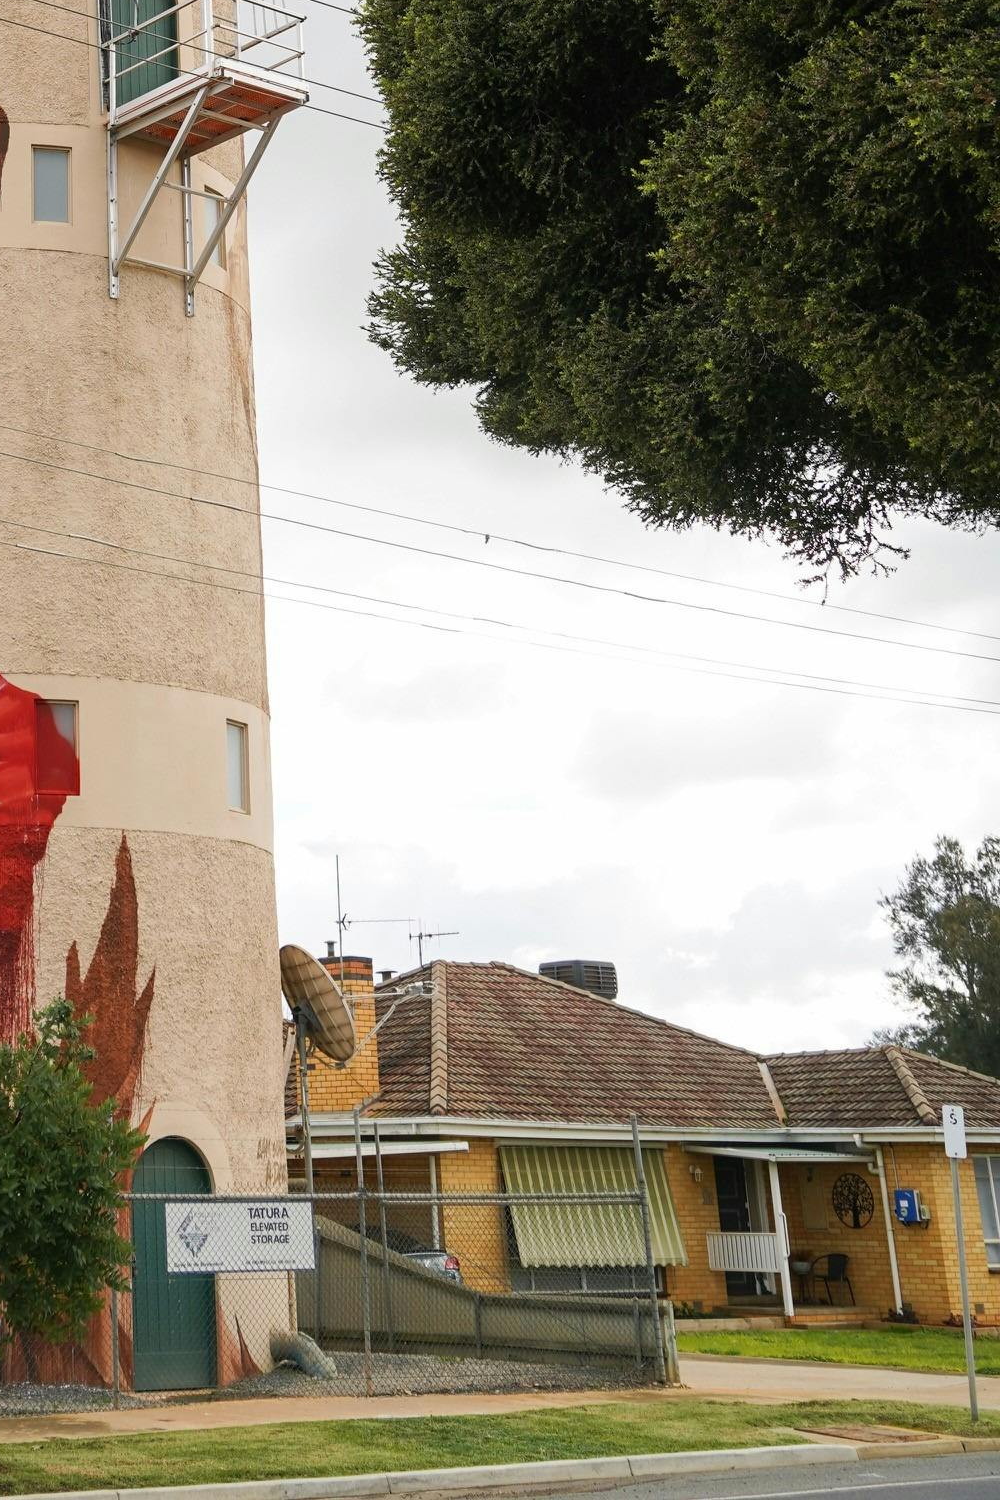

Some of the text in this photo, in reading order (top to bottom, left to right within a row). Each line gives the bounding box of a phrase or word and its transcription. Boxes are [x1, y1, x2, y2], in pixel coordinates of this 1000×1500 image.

[247, 1207, 289, 1219] TATURA
[250, 1222, 289, 1231] ELEVATED
[250, 1234, 290, 1244] STORAGE
